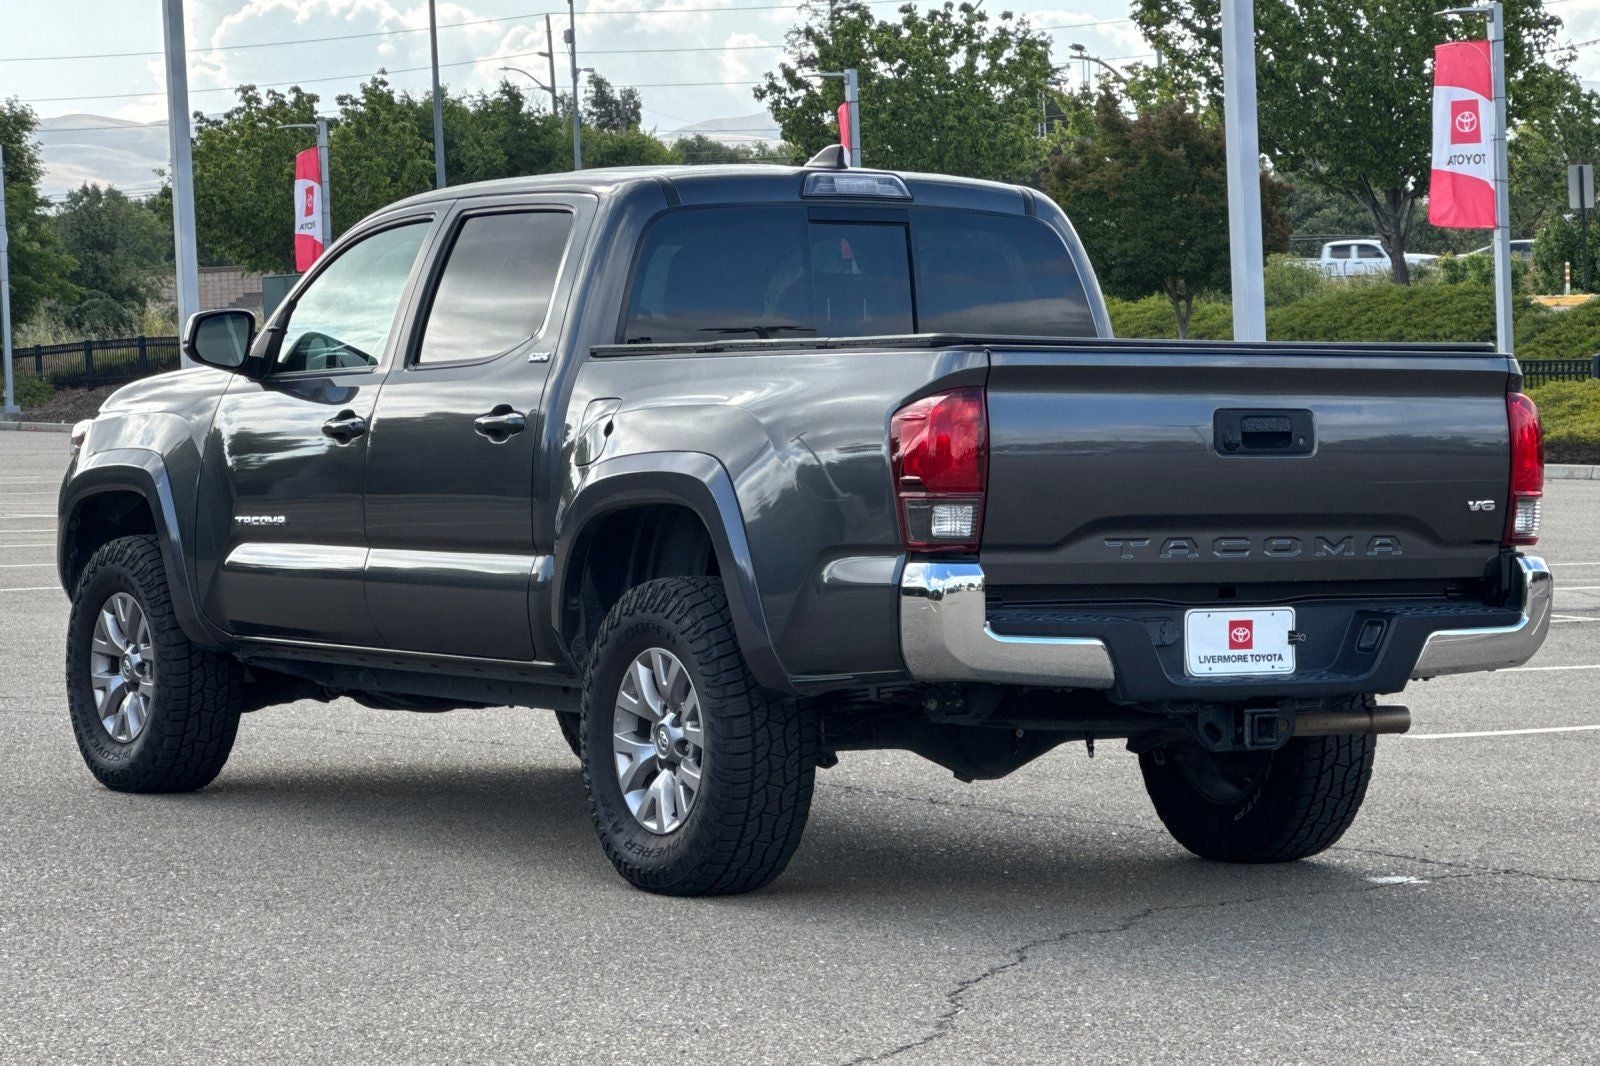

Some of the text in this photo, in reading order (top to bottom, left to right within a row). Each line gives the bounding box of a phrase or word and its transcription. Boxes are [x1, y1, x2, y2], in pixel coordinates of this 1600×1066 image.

[1467, 500, 1496, 511] V6
[1104, 535, 1402, 559] TACOMA
[1198, 653, 1284, 664] LIVERMORE TOYOTA
